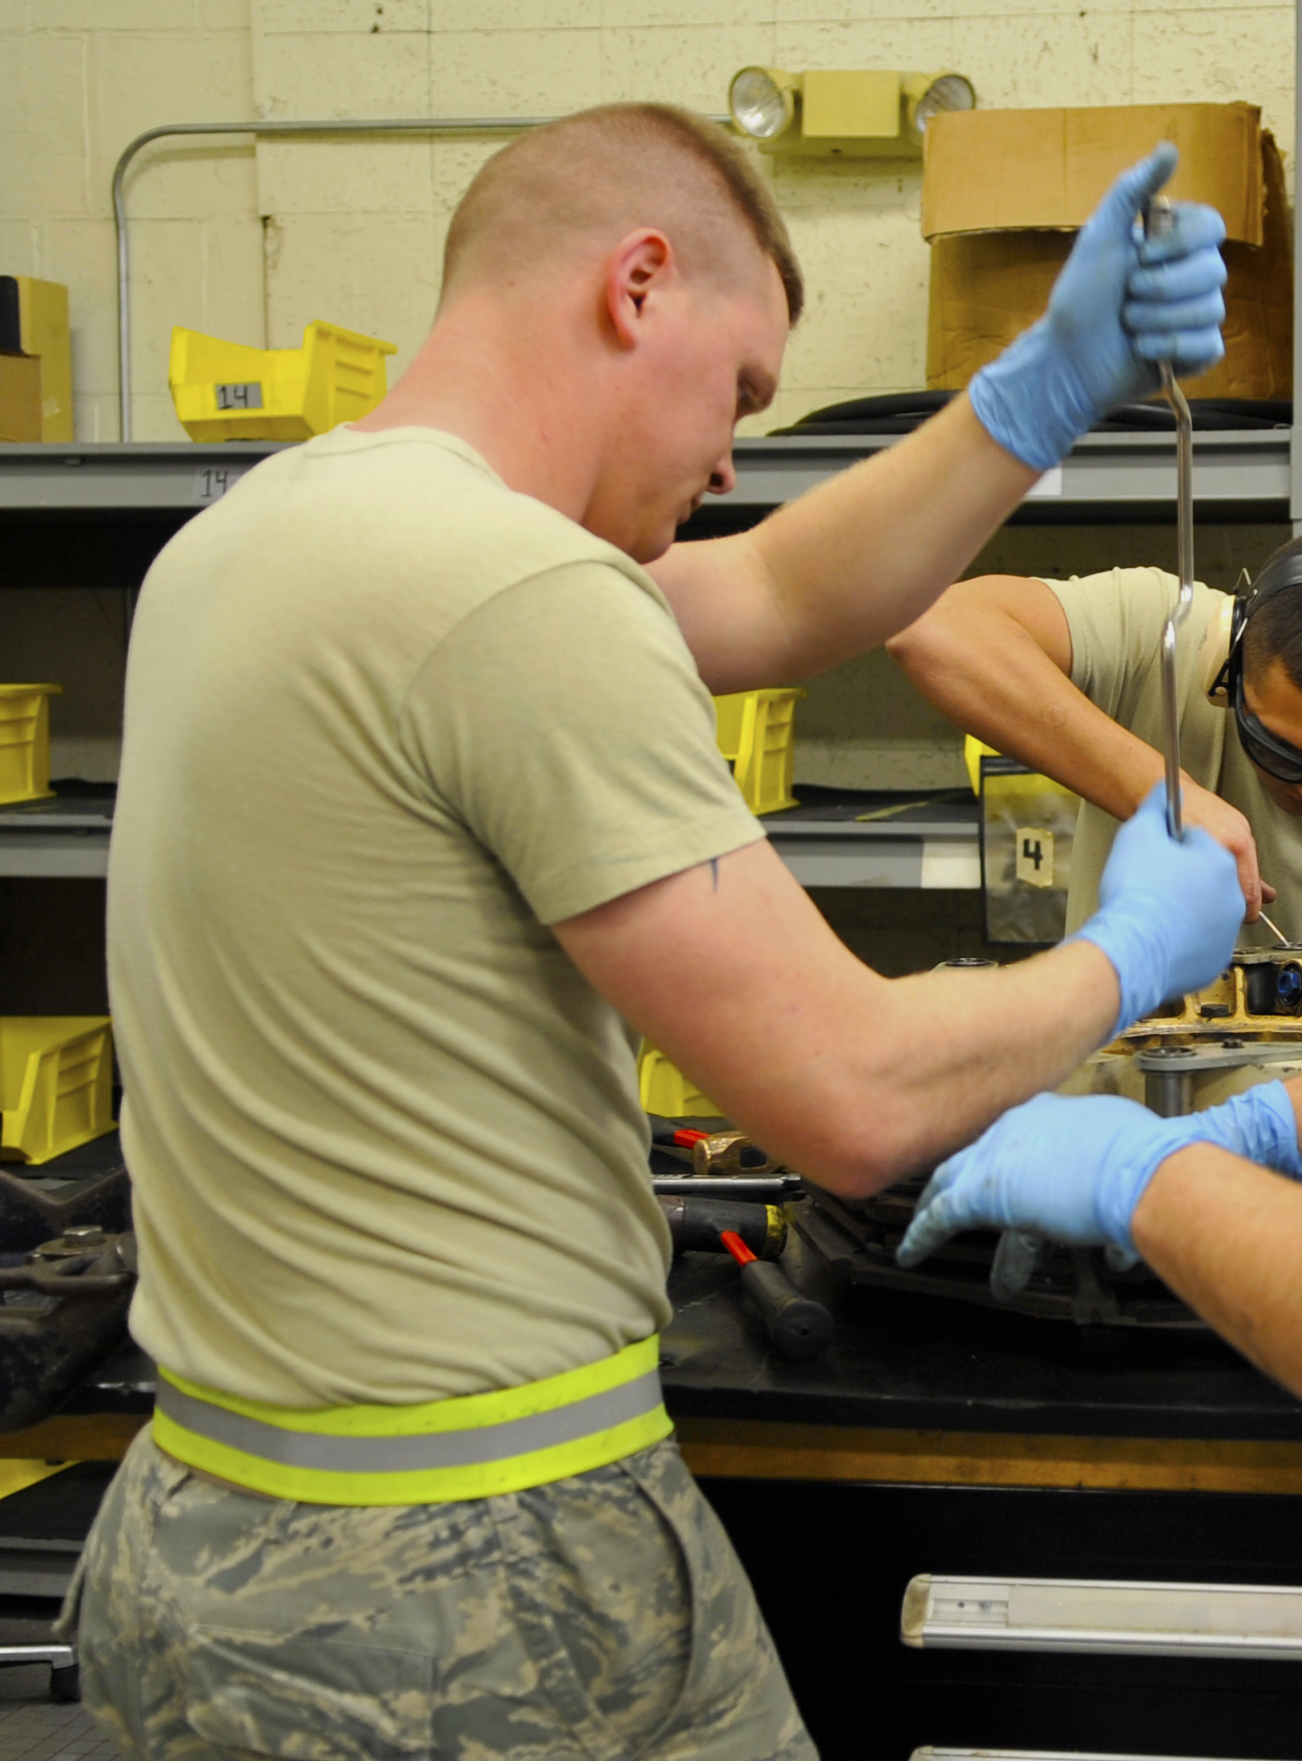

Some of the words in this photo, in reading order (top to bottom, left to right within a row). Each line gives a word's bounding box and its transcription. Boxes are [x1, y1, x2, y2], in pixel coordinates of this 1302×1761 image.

[220, 384, 249, 409] 14
[201, 468, 229, 497] 14
[1023, 838, 1043, 870] 4
